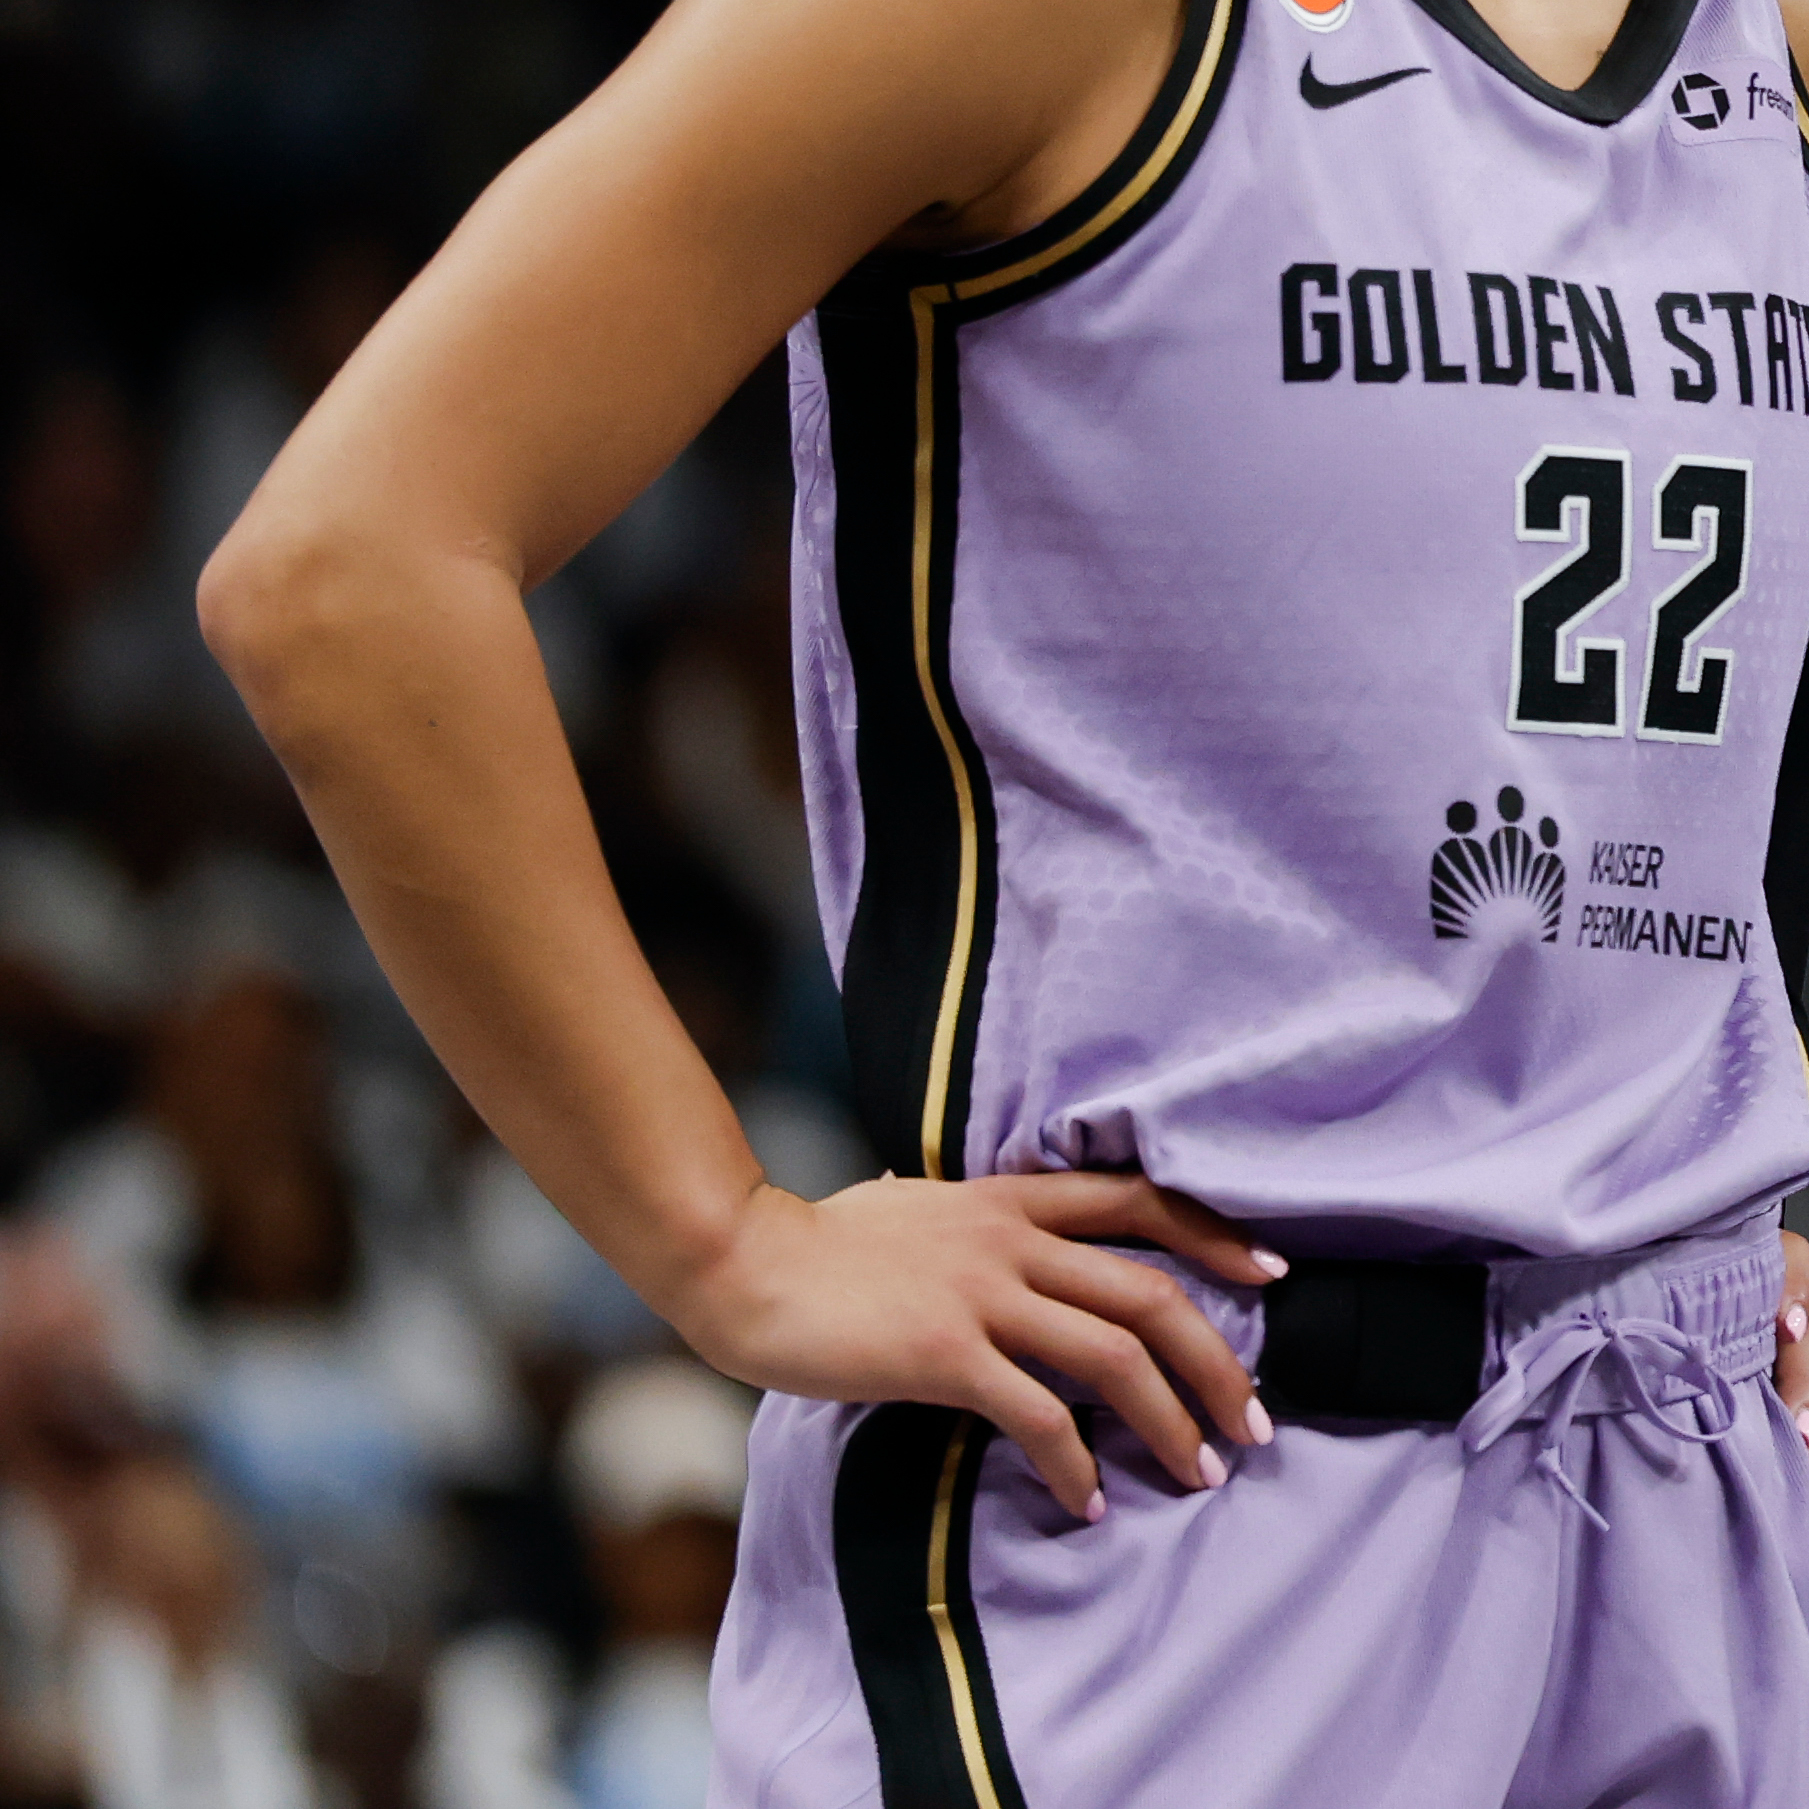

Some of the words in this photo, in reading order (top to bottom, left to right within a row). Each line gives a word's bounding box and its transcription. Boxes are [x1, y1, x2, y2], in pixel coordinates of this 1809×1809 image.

[1281, 263, 1635, 396] GOLDEN
[1507, 444, 1753, 746] 22
[1589, 841, 1664, 890] KAISER
